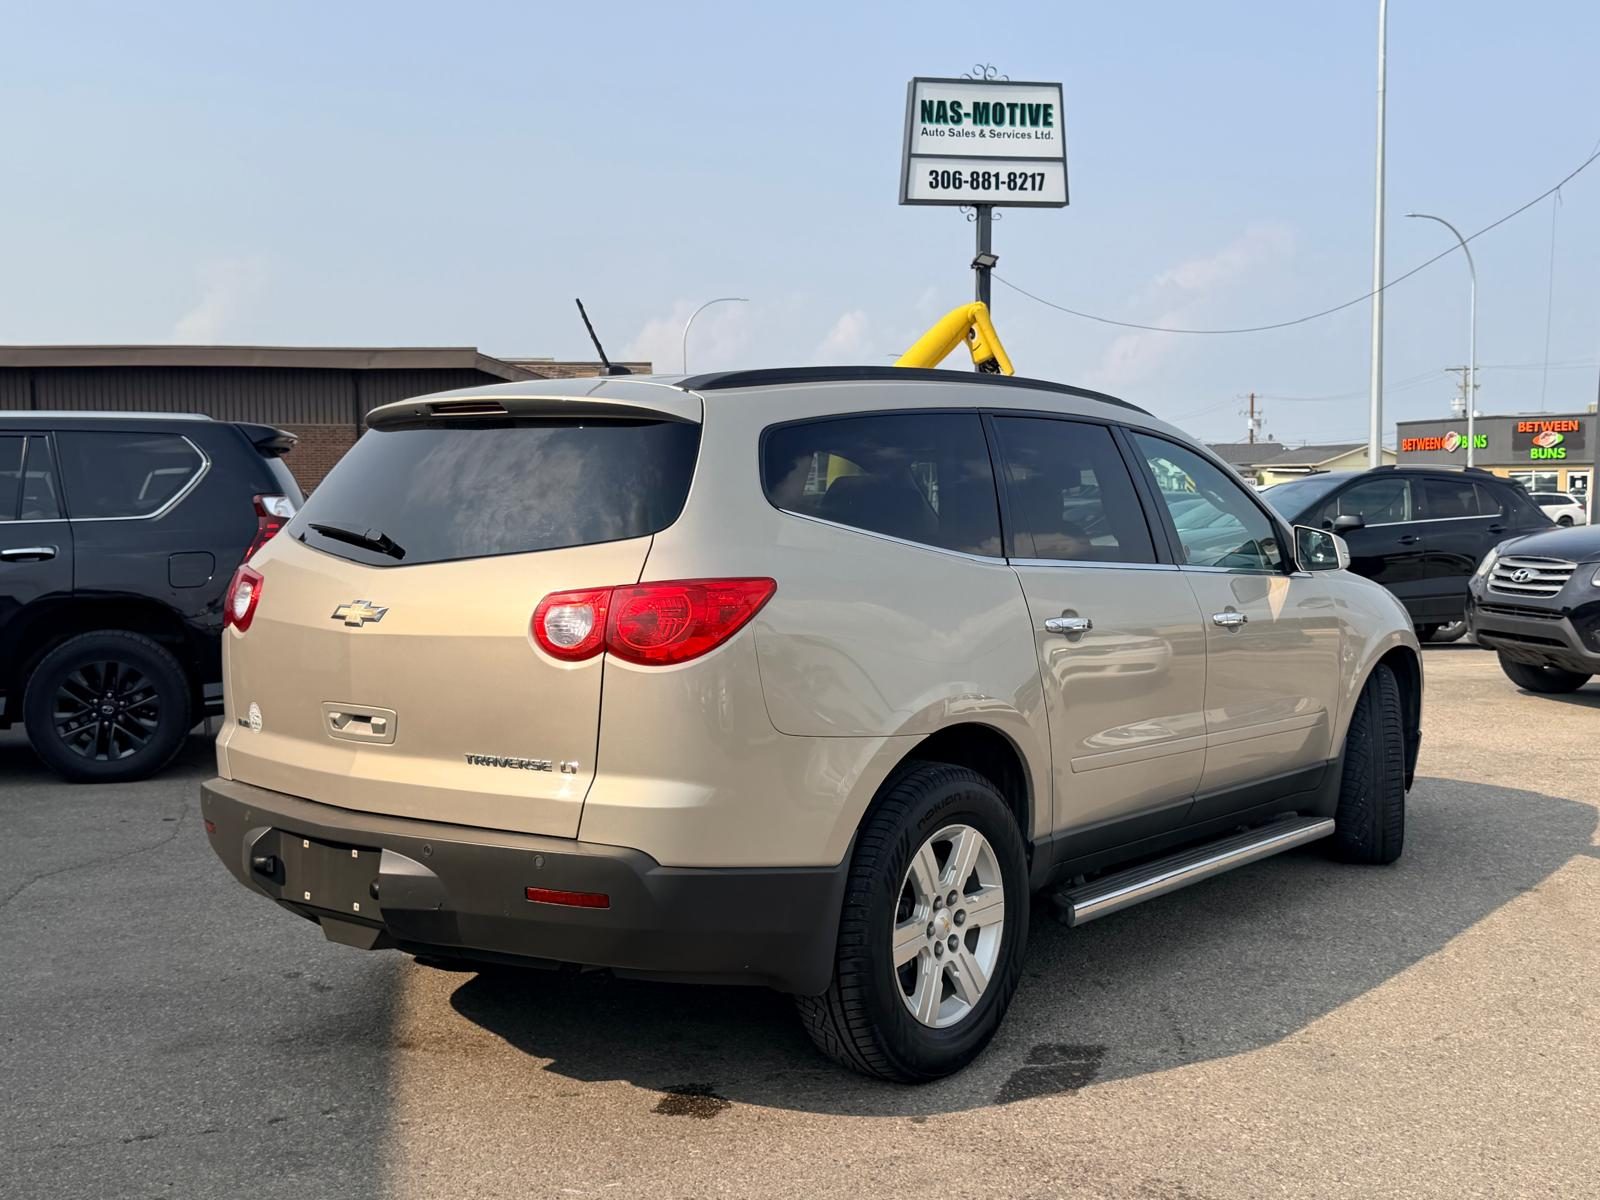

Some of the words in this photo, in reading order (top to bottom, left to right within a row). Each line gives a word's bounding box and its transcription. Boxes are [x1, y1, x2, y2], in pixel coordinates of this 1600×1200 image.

[920, 99, 1054, 128] NAS-MOTIVE
[920, 127, 946, 137] Auto
[947, 128, 976, 138] Sales
[978, 129, 987, 138] &
[988, 129, 1032, 140] Services
[1034, 130, 1054, 140] Ltd.
[928, 169, 1046, 191] 306-881-8217
[1517, 420, 1579, 433] BETWEEN
[1402, 438, 1442, 451] BETWEEN
[1461, 434, 1488, 449] BNS
[1530, 447, 1567, 459] BUNS
[464, 752, 553, 772] TRAVERSE
[560, 760, 579, 774] LT
